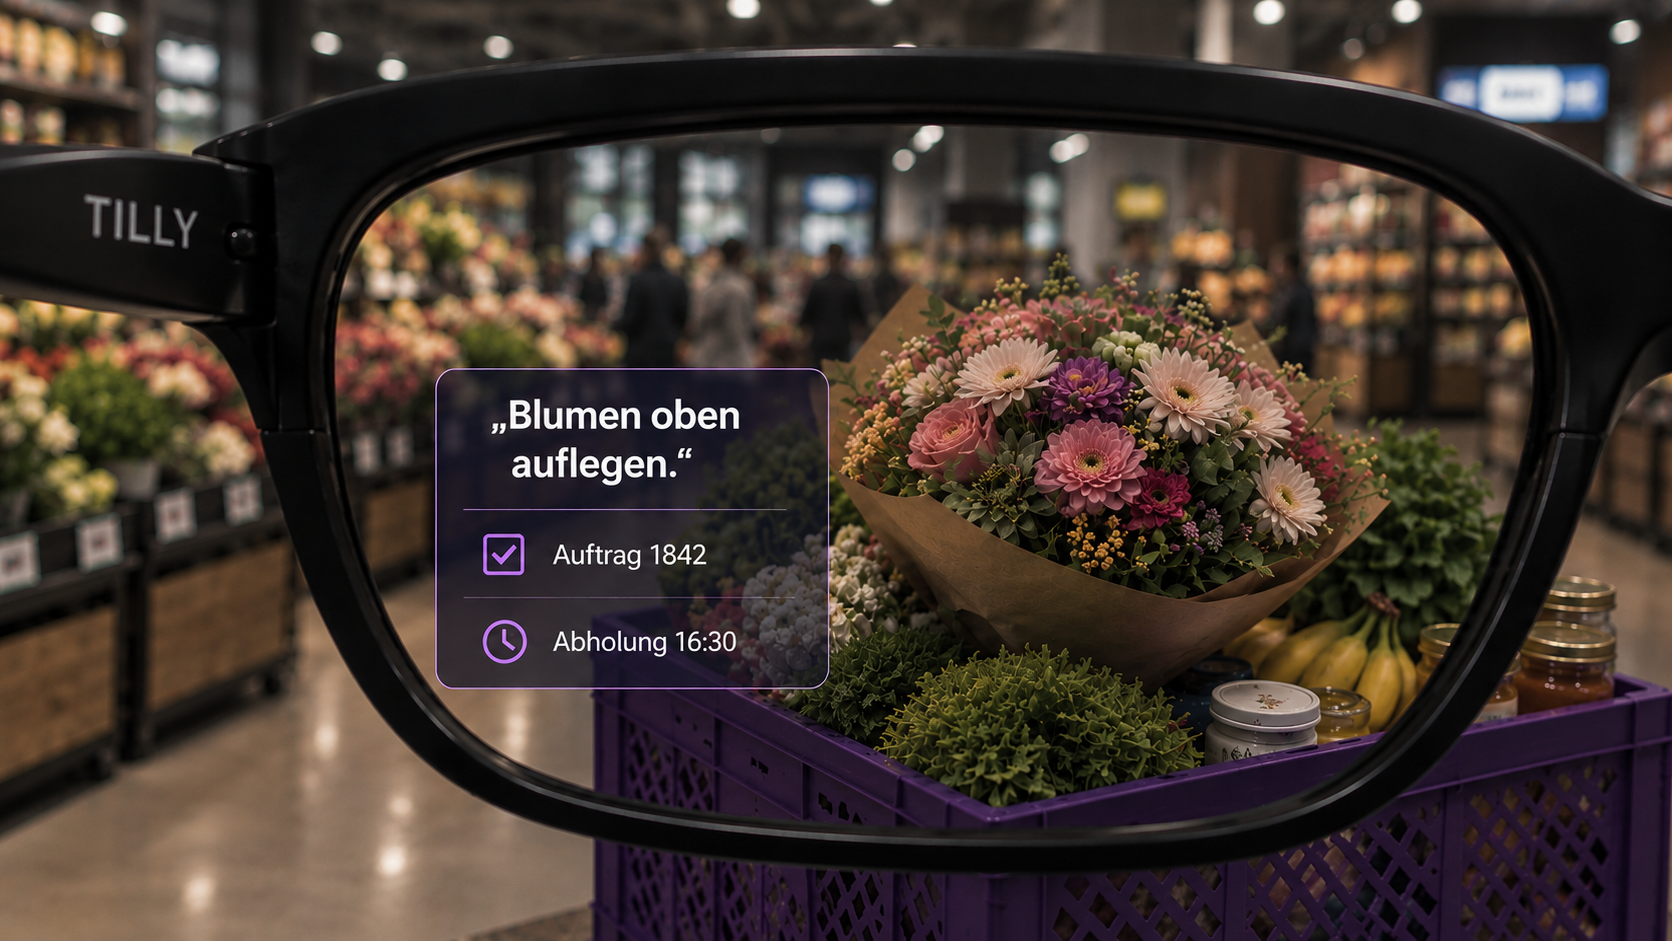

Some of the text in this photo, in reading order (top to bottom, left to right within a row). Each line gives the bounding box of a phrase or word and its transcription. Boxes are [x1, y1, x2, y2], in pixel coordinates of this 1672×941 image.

[83, 193, 199, 249] TILLY
[491, 398, 740, 435] „Blumen oben
[511, 446, 693, 486] auflegen.“
[552, 542, 707, 571] Auftrag 1842
[552, 630, 737, 658] Abholung 16:30
